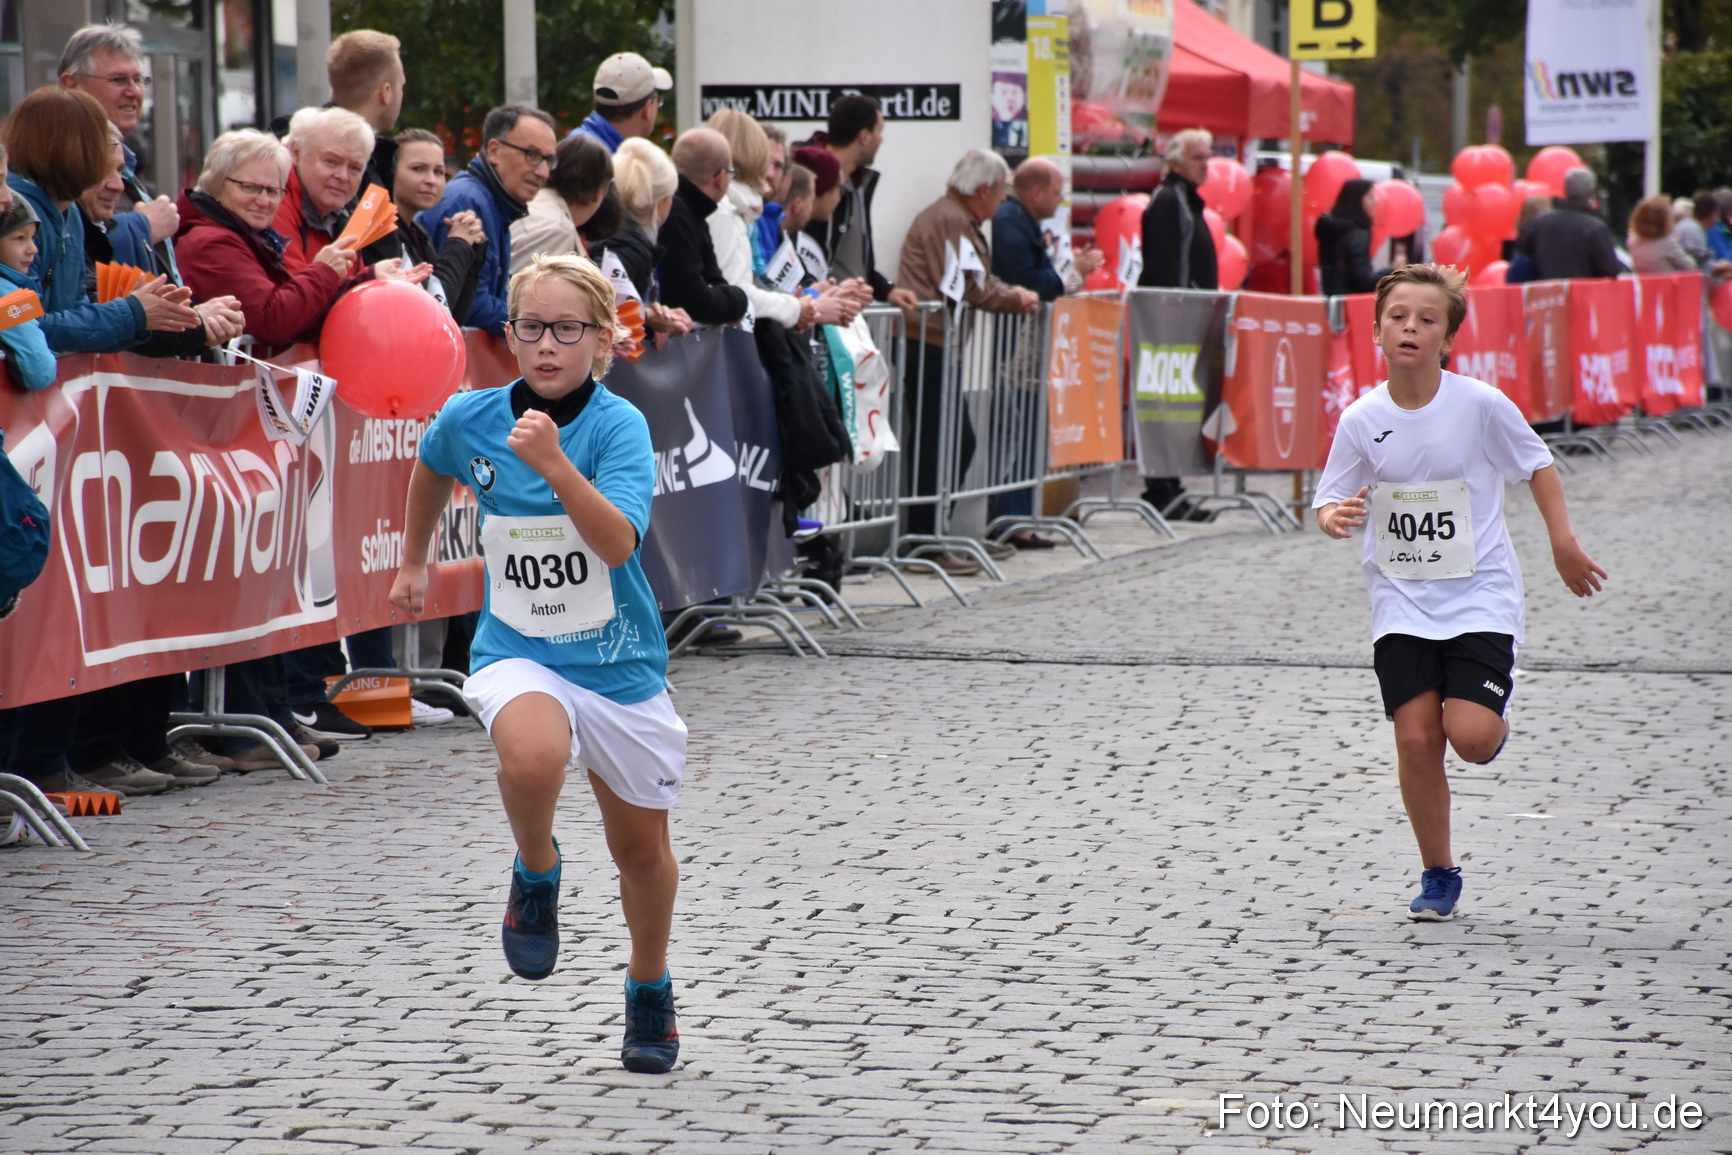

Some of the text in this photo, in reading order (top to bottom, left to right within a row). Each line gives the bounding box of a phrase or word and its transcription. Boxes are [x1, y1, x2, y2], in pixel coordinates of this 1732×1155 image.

[1136, 349, 1198, 395] BOCK
[305, 373, 323, 417] swn
[1402, 491, 1438, 500] BOCK
[521, 527, 565, 538] BOCK
[1388, 511, 1456, 542] 4045
[504, 551, 588, 590] 4030
[531, 603, 566, 616] Anton
[1483, 680, 1505, 697] JAKO
